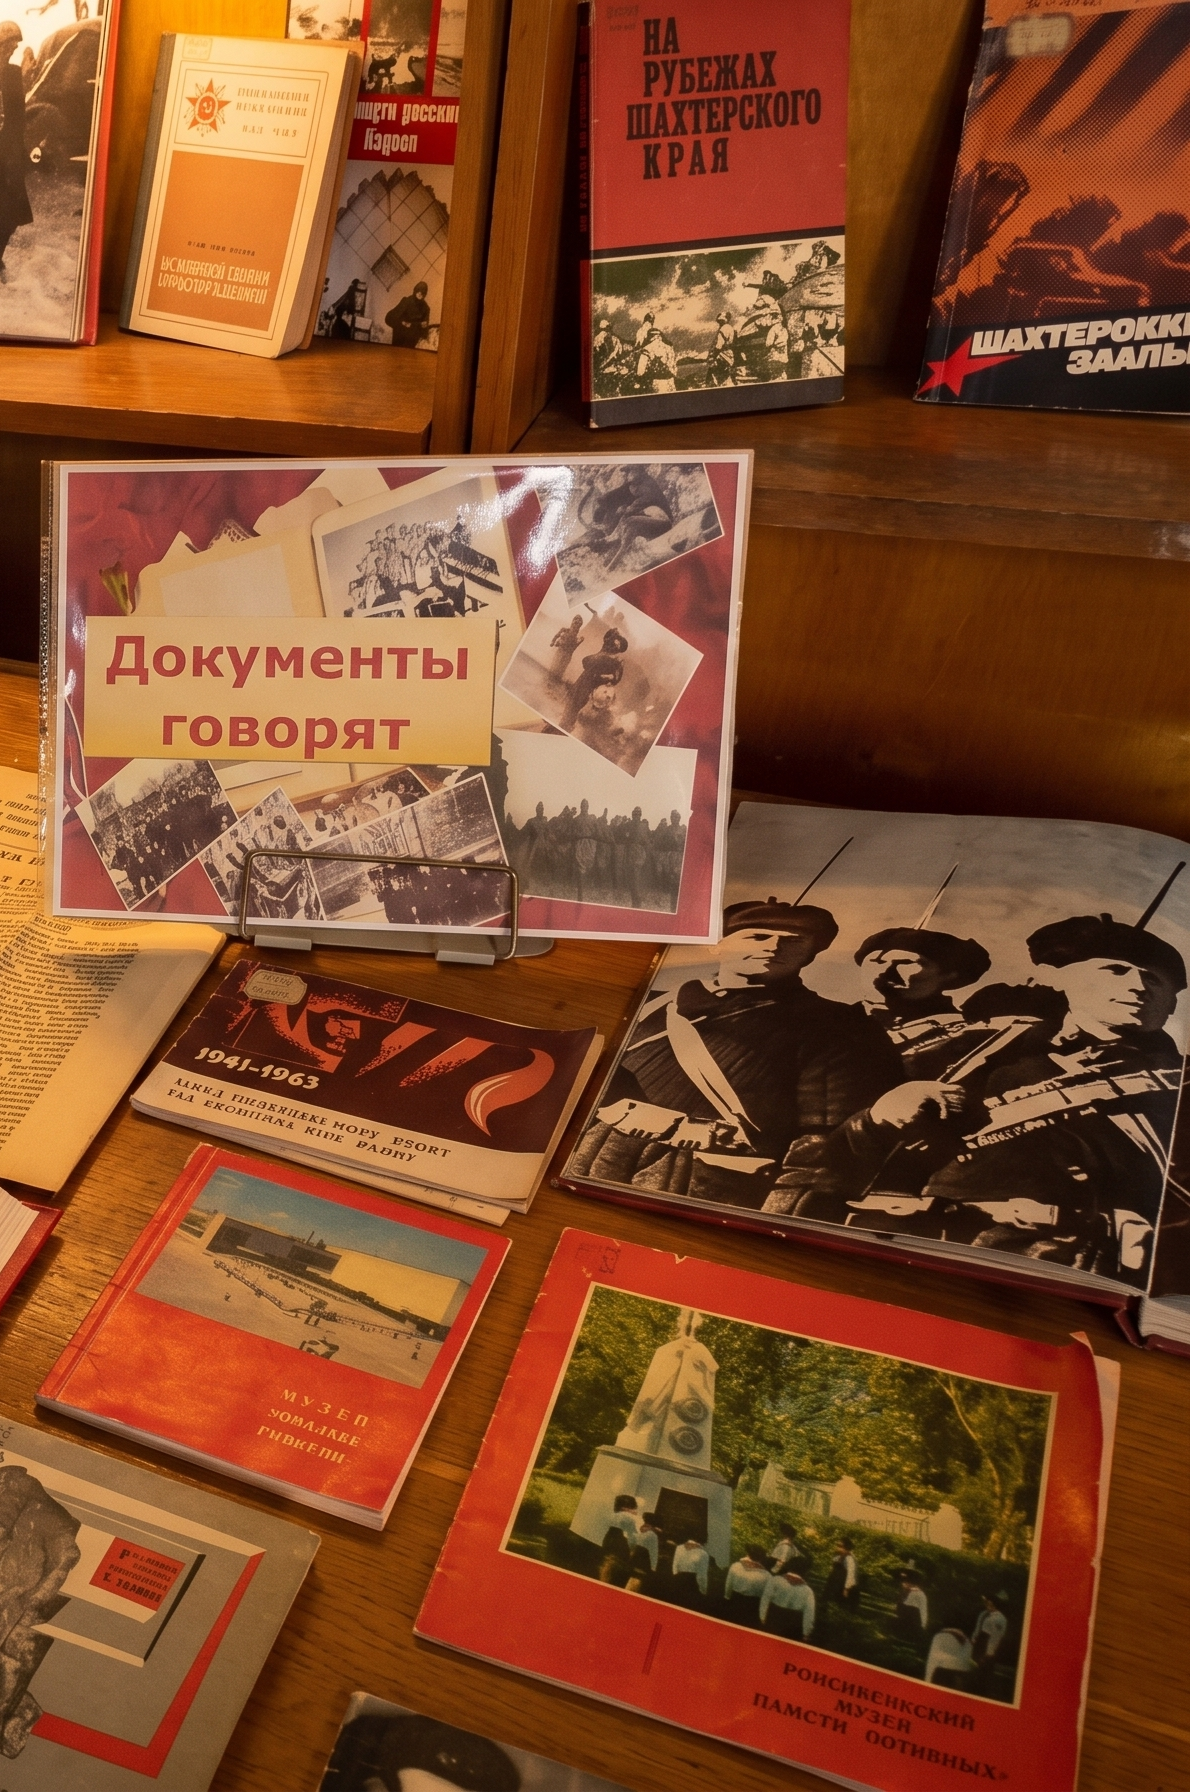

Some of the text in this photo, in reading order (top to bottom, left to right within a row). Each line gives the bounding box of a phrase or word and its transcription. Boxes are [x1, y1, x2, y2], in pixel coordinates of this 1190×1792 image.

[643, 17, 680, 56] НА
[643, 50, 777, 98] РУБЕЖАХ
[626, 88, 822, 141] ШАХТЕРСКОГО
[643, 137, 729, 180] КРАЯ
[107, 635, 469, 689] Документы
[161, 711, 411, 759] говорят
[194, 1047, 320, 1091] 1941-1963
